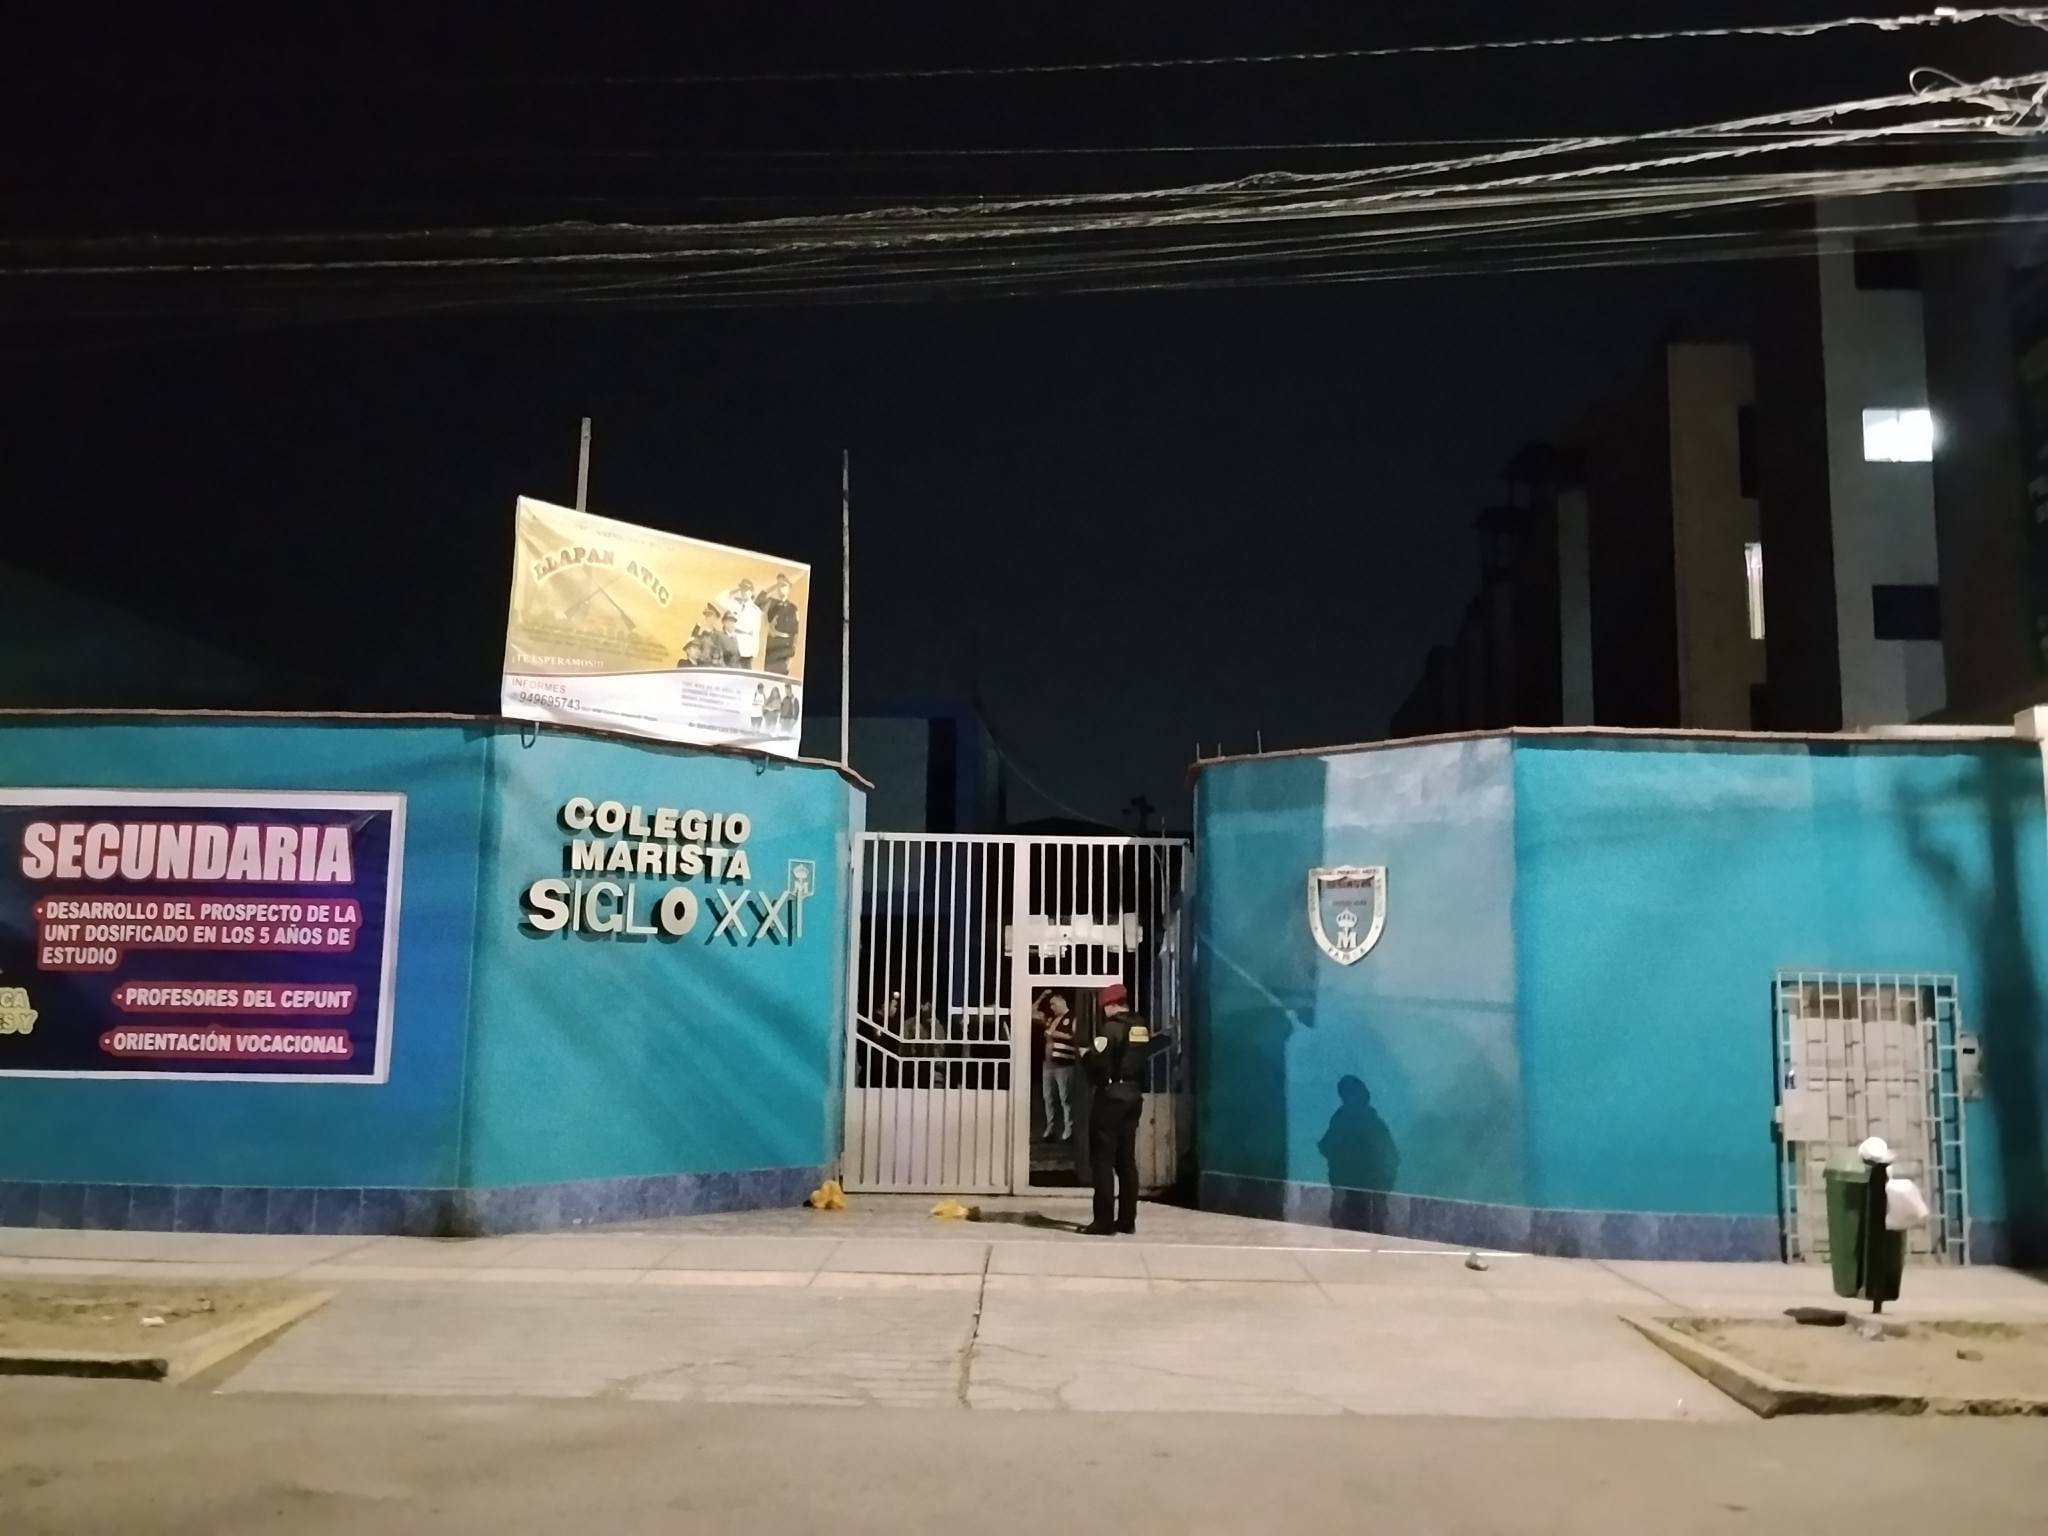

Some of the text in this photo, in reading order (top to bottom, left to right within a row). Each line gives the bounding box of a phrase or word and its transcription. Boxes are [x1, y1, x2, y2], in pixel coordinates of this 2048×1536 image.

[512, 677, 567, 694] INFORMES
[519, 691, 581, 711] 949695743
[564, 797, 751, 844] COLEGIO
[22, 822, 353, 882] SECUNDARIA
[571, 839, 751, 880] MARISTA
[46, 902, 357, 923] DESARROLLO DEL PROSPECTO DE LA
[528, 879, 803, 938] SIGLO XXI
[44, 924, 350, 946] UNT DOSIFICADO EN LOS 5 AÑOS DE
[42, 947, 118, 965] ESTUDIO
[125, 988, 352, 1009] PROFESORES DEL CEPUNT
[113, 1030, 348, 1053] ORIENTACIÓN VOCACIONAL
